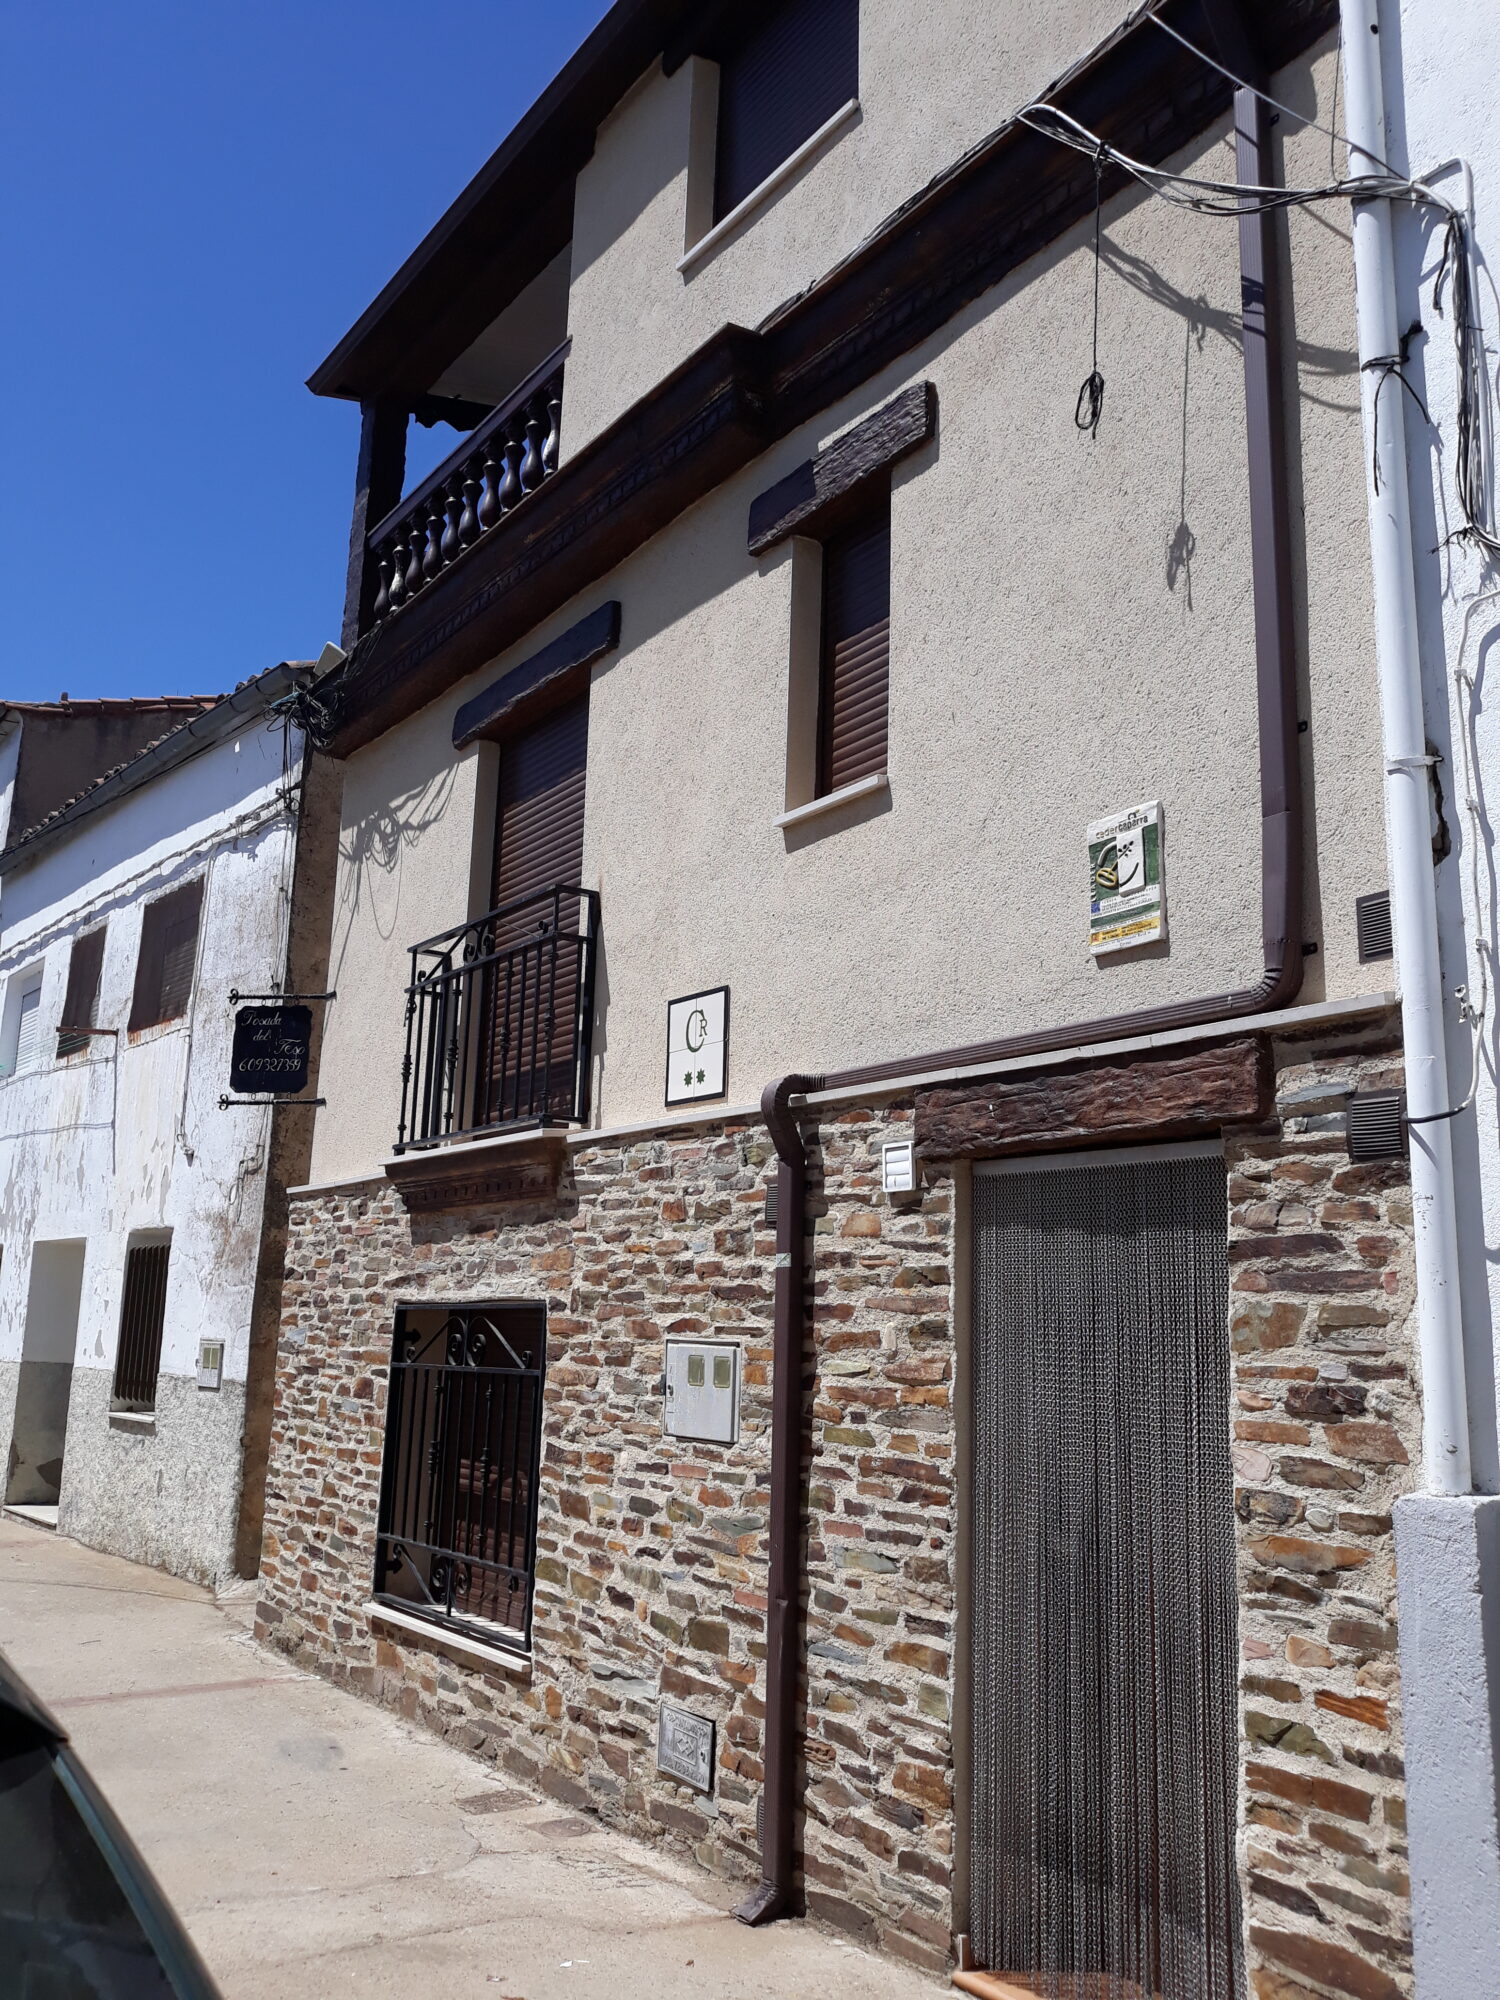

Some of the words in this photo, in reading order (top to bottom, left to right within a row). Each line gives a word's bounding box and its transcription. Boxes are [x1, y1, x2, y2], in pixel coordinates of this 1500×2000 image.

[241, 1010, 282, 1026] Posada
[252, 1029, 271, 1041] del
[273, 1038, 306, 1055] Teso
